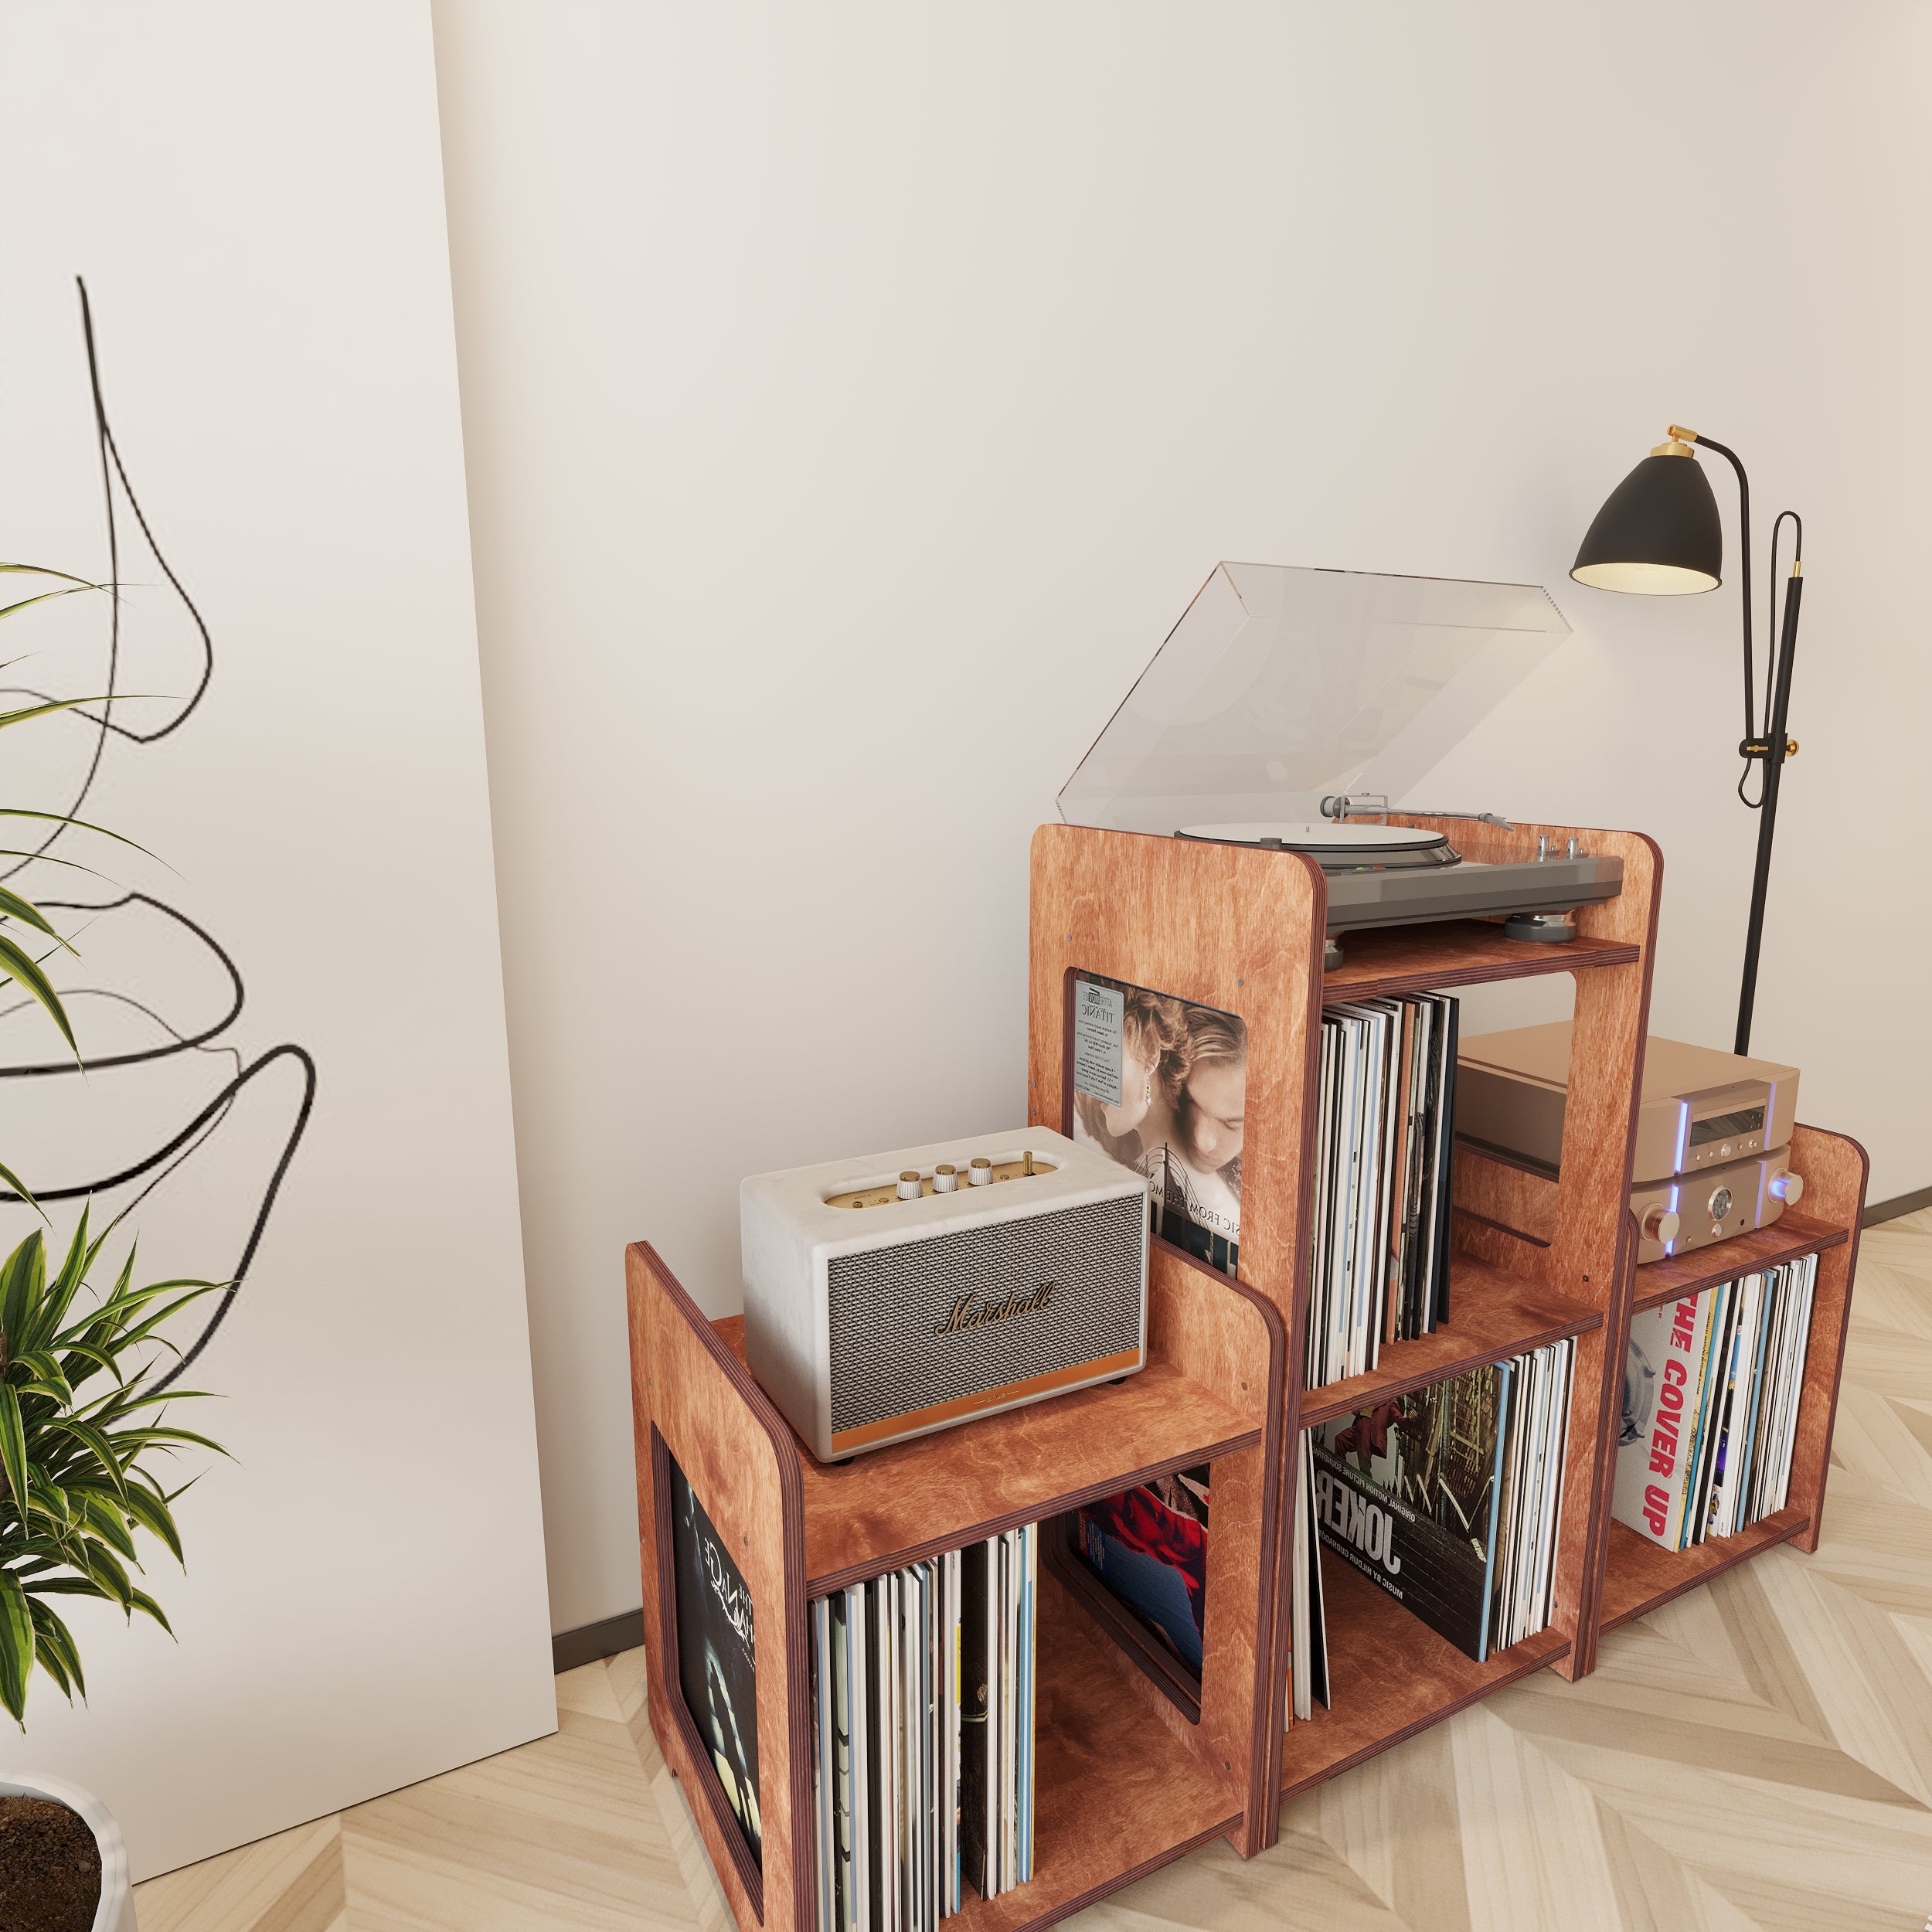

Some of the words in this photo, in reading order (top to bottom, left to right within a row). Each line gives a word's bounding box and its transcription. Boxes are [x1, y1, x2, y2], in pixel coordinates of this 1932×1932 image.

[934, 1282, 1057, 1338] Marshall
[1670, 1293, 1699, 1353] THE
[1648, 1359, 1688, 1480] COVER
[1642, 1486, 1671, 1541] UP
